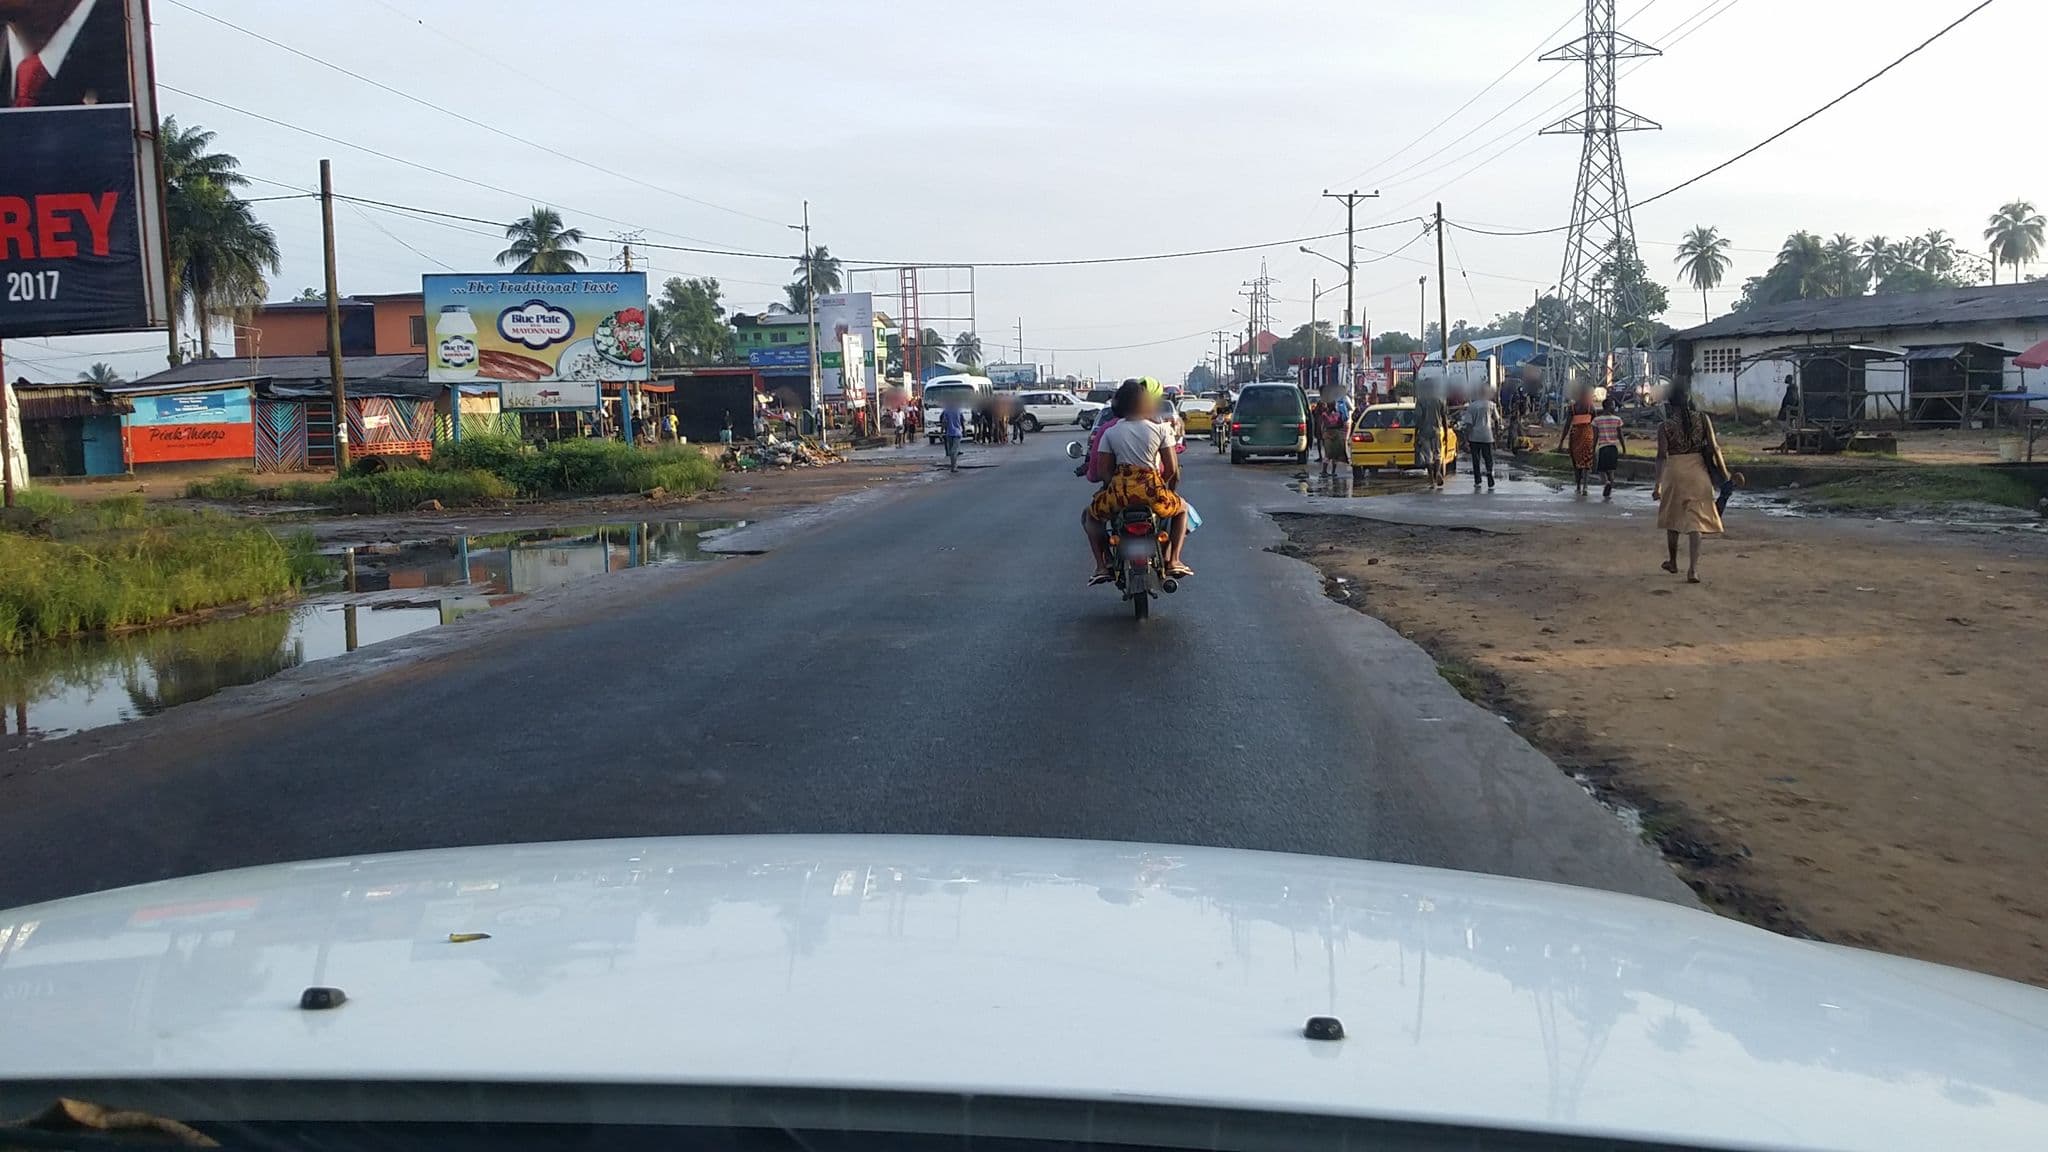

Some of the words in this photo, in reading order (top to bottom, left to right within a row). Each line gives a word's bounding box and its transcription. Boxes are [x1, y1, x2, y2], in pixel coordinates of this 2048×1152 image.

[7, 271, 60, 301] 2017
[498, 280, 578, 294] Traditional
[581, 280, 619, 294] Taste
[512, 314, 534, 324] Blue
[536, 314, 561, 324] Plate
